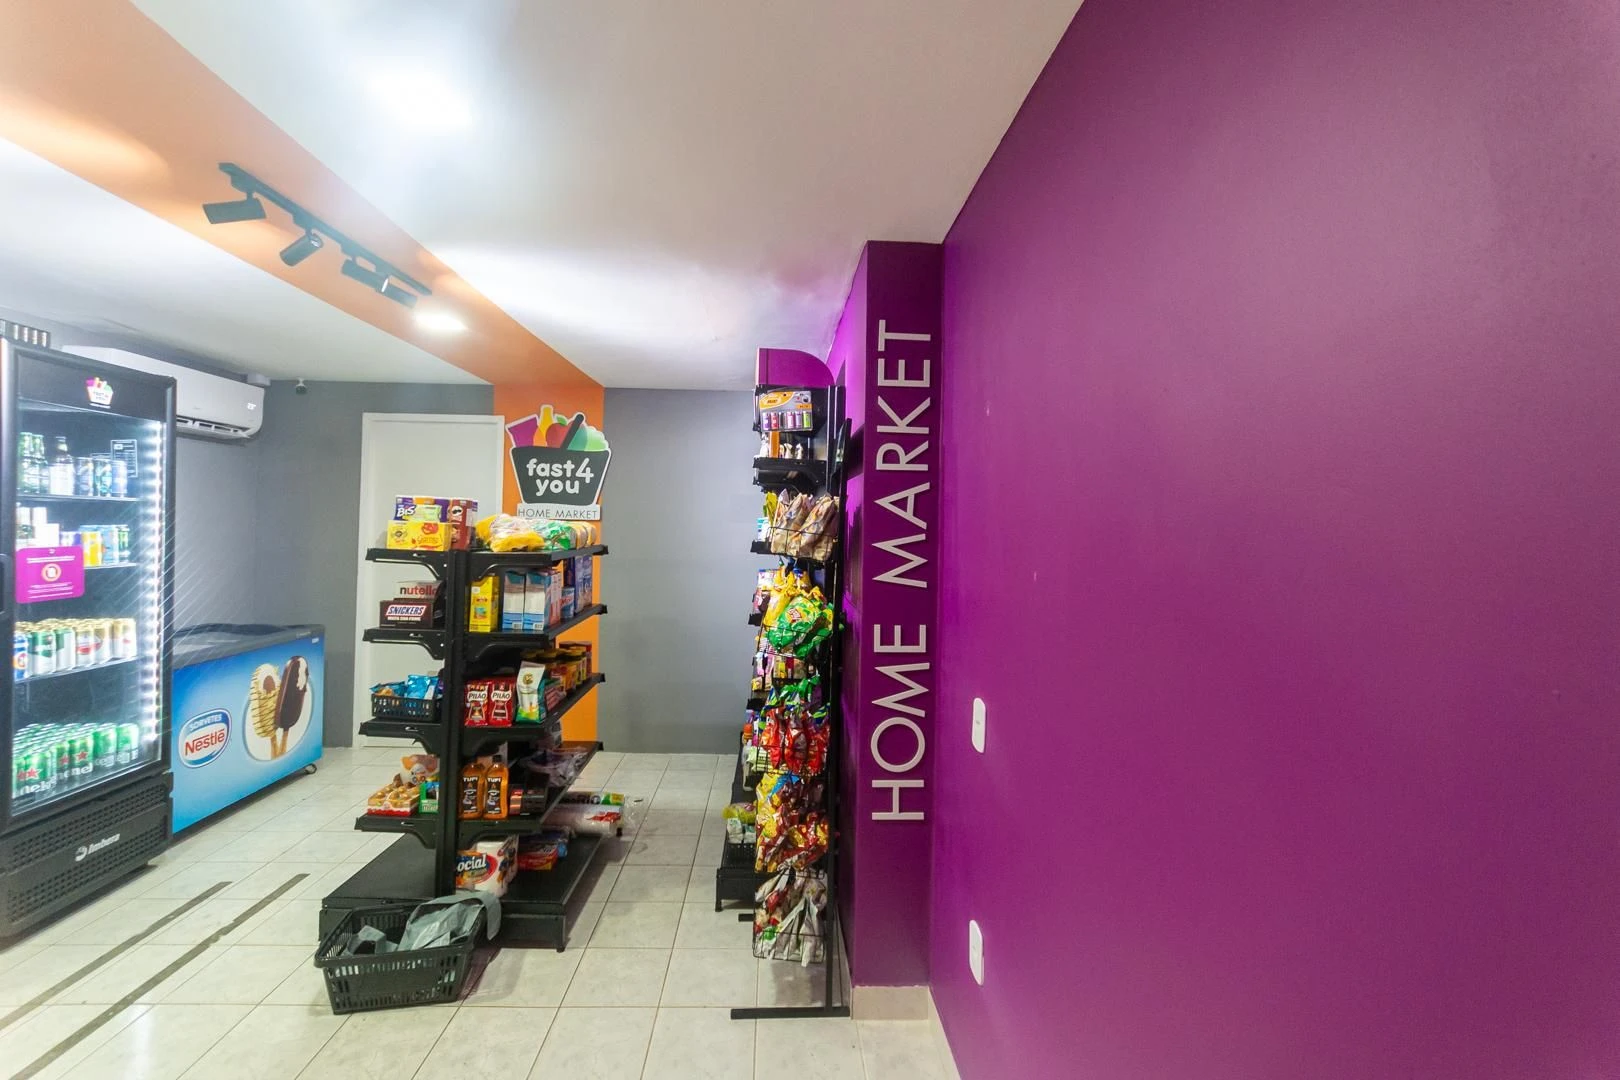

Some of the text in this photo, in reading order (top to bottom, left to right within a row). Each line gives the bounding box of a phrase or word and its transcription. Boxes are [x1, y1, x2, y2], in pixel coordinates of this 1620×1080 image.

[535, 479, 580, 497] you
[518, 508, 598, 519] HOME MARKET
[870, 319, 932, 821] HOME MARKET
[388, 605, 424, 616] SNICKERS
[456, 853, 487, 873] ocial
